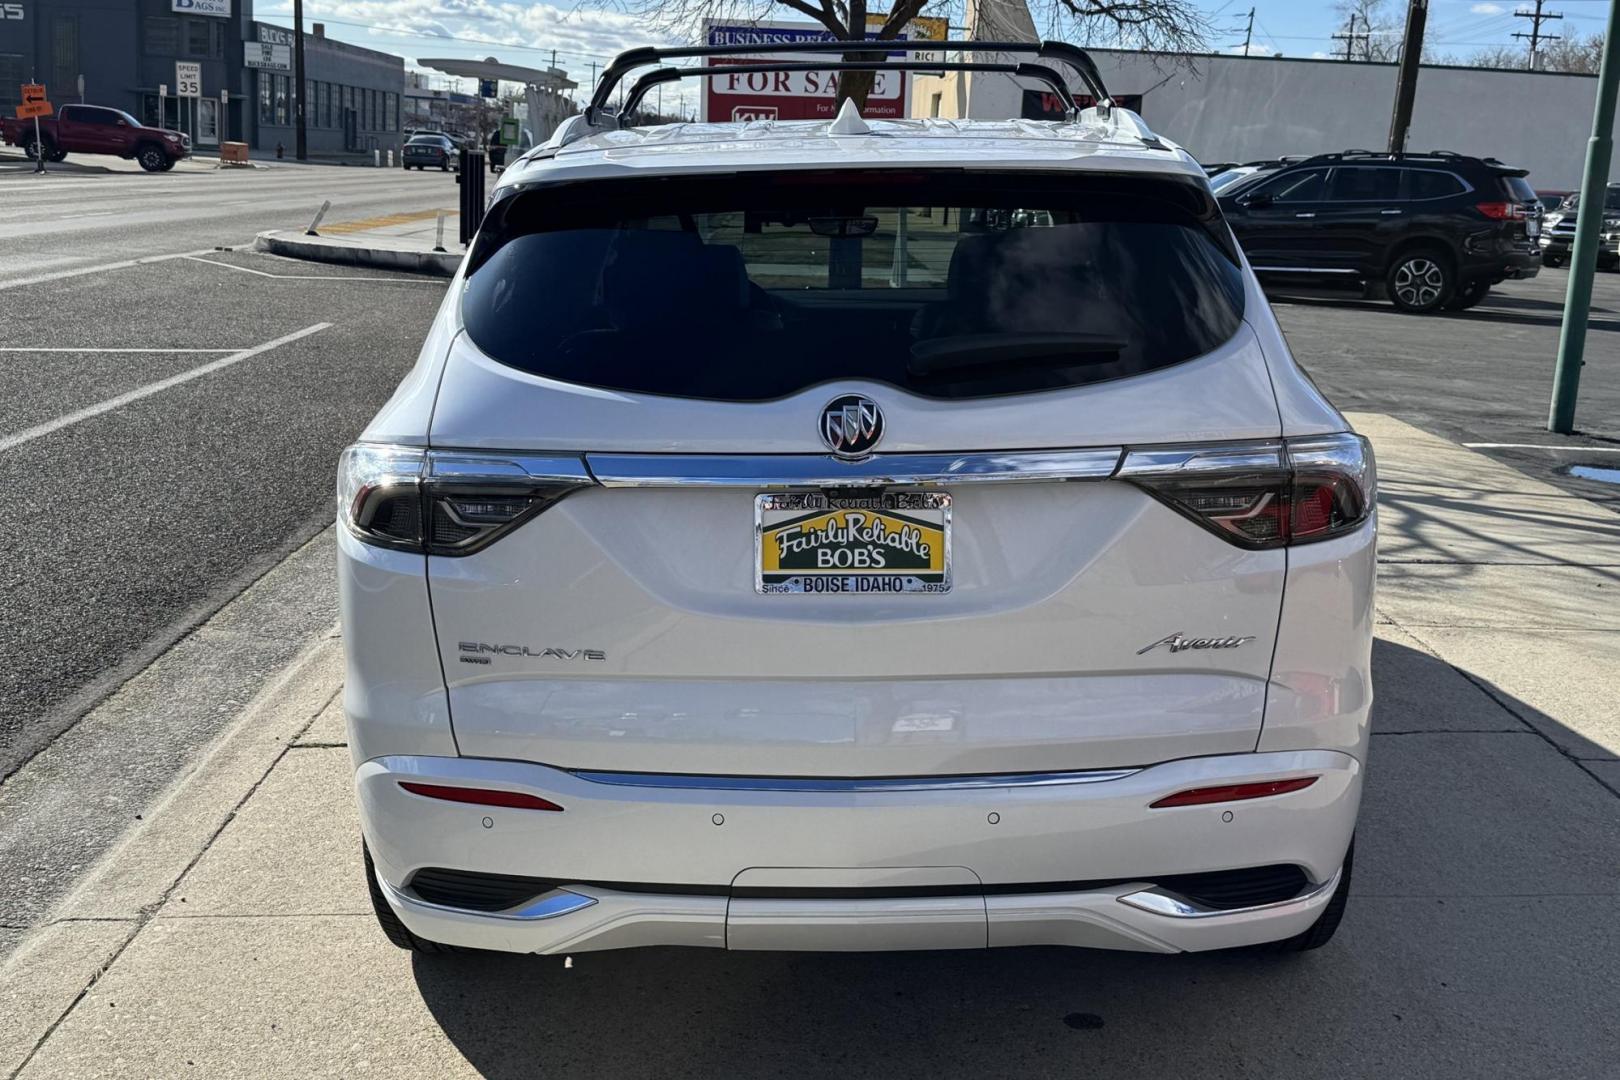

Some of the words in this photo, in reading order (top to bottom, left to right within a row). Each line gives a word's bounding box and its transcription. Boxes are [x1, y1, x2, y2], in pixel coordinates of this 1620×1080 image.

[714, 31, 791, 46] BUSINESS
[179, 81, 198, 94] 35
[727, 71, 792, 92] FOR
[804, 71, 886, 95] SAE
[817, 104, 829, 112] For
[776, 517, 848, 560] Fairly
[845, 513, 930, 560] Reliable
[817, 544, 886, 568] BOB'S
[803, 577, 849, 593] BOISE
[855, 577, 903, 593] IDAHO
[922, 584, 945, 593] 1975
[458, 641, 606, 662] ENCLAVE
[1136, 631, 1256, 655] Avenir
